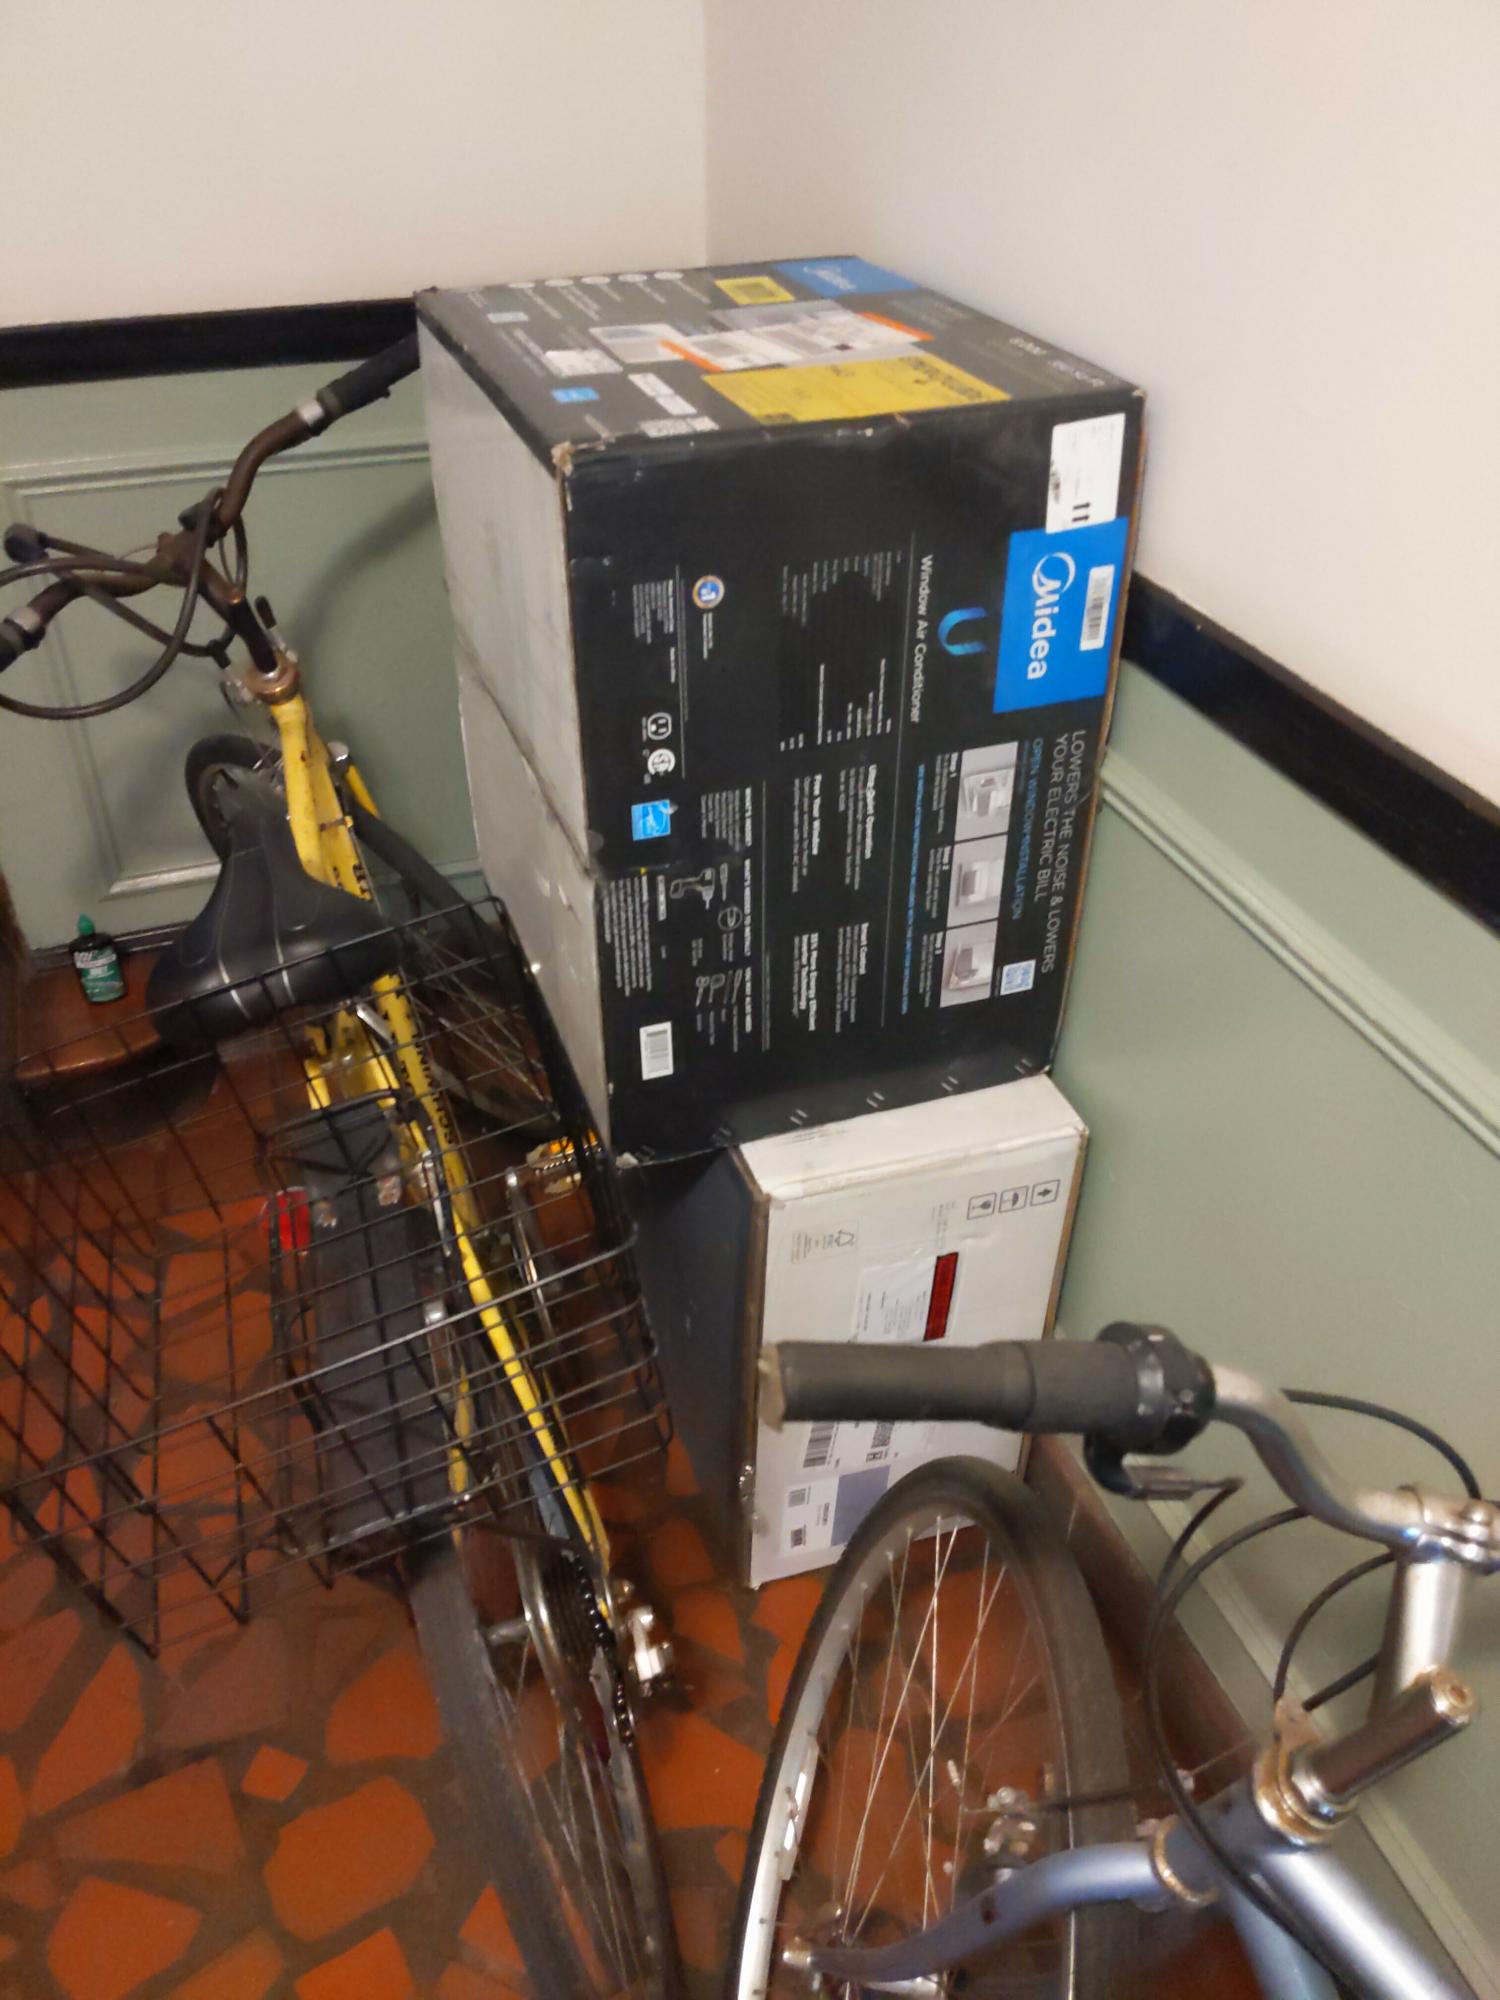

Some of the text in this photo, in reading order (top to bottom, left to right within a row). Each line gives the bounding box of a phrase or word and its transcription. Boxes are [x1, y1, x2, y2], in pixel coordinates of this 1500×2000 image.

[910, 554, 933, 724] Window Air Conditioner
[1027, 551, 1076, 680] Midea
[1028, 737, 1042, 774] OPEN
[811, 774, 821, 855] Free Your Window
[863, 764, 876, 859] Ultra-Quiet Operation
[1034, 733, 1067, 901] YOUR ELECTRIC BILL
[1041, 729, 1085, 973] LOWERS THE NOISE & LOWERS
[799, 934, 808, 1010] Inverter Technology
[808, 970, 817, 998] Energy
[809, 950, 818, 970] More
[859, 922, 868, 975] Smart Control
[807, 999, 816, 1031] Efficient
